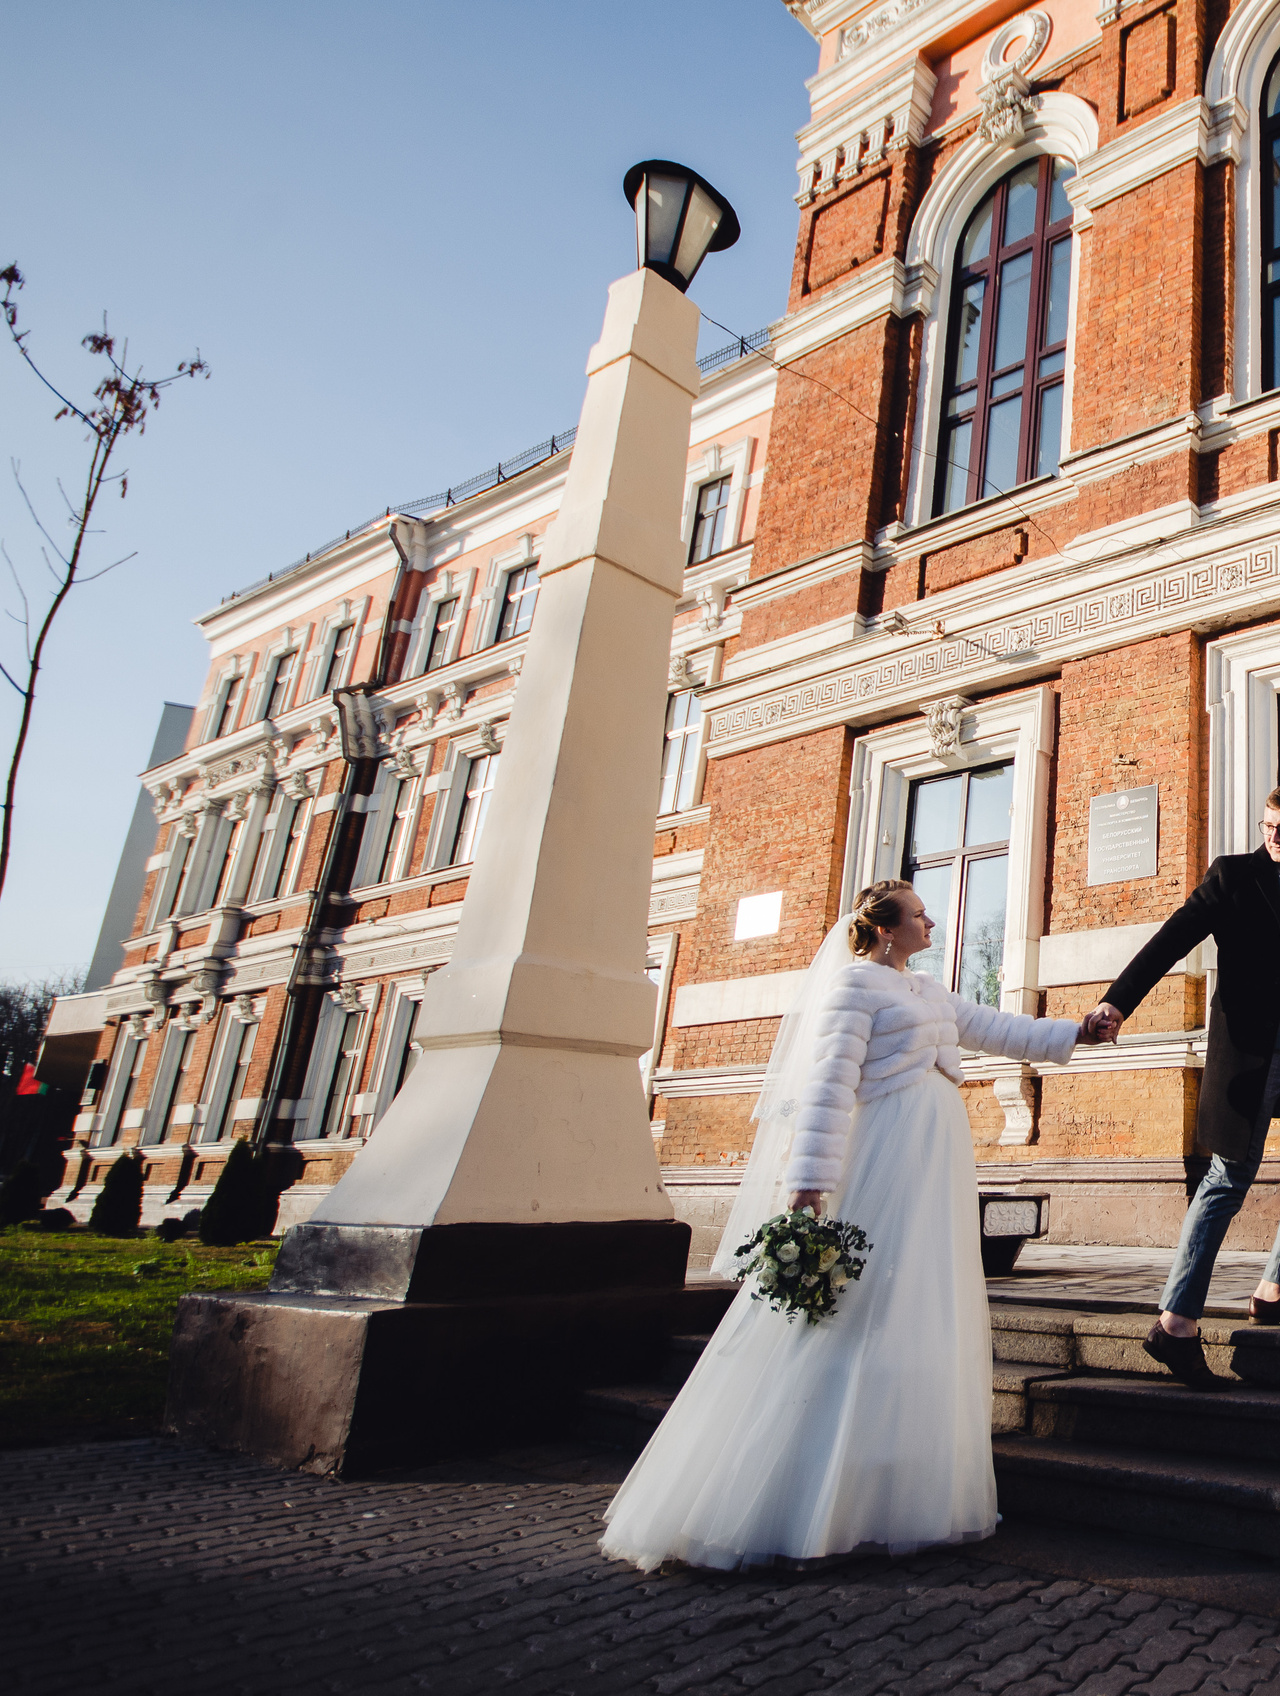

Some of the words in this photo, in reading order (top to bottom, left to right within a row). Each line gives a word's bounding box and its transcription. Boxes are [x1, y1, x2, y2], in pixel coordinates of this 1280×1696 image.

[1102, 826, 1143, 839] БЕЛОРУССКИЙ
[1094, 837, 1150, 852] ГОСУДАРСТВЕННЫЙ
[1102, 851, 1142, 863] УНИВЕРСИТЕТ
[1104, 864, 1140, 875] ТРАНСПОРТА
